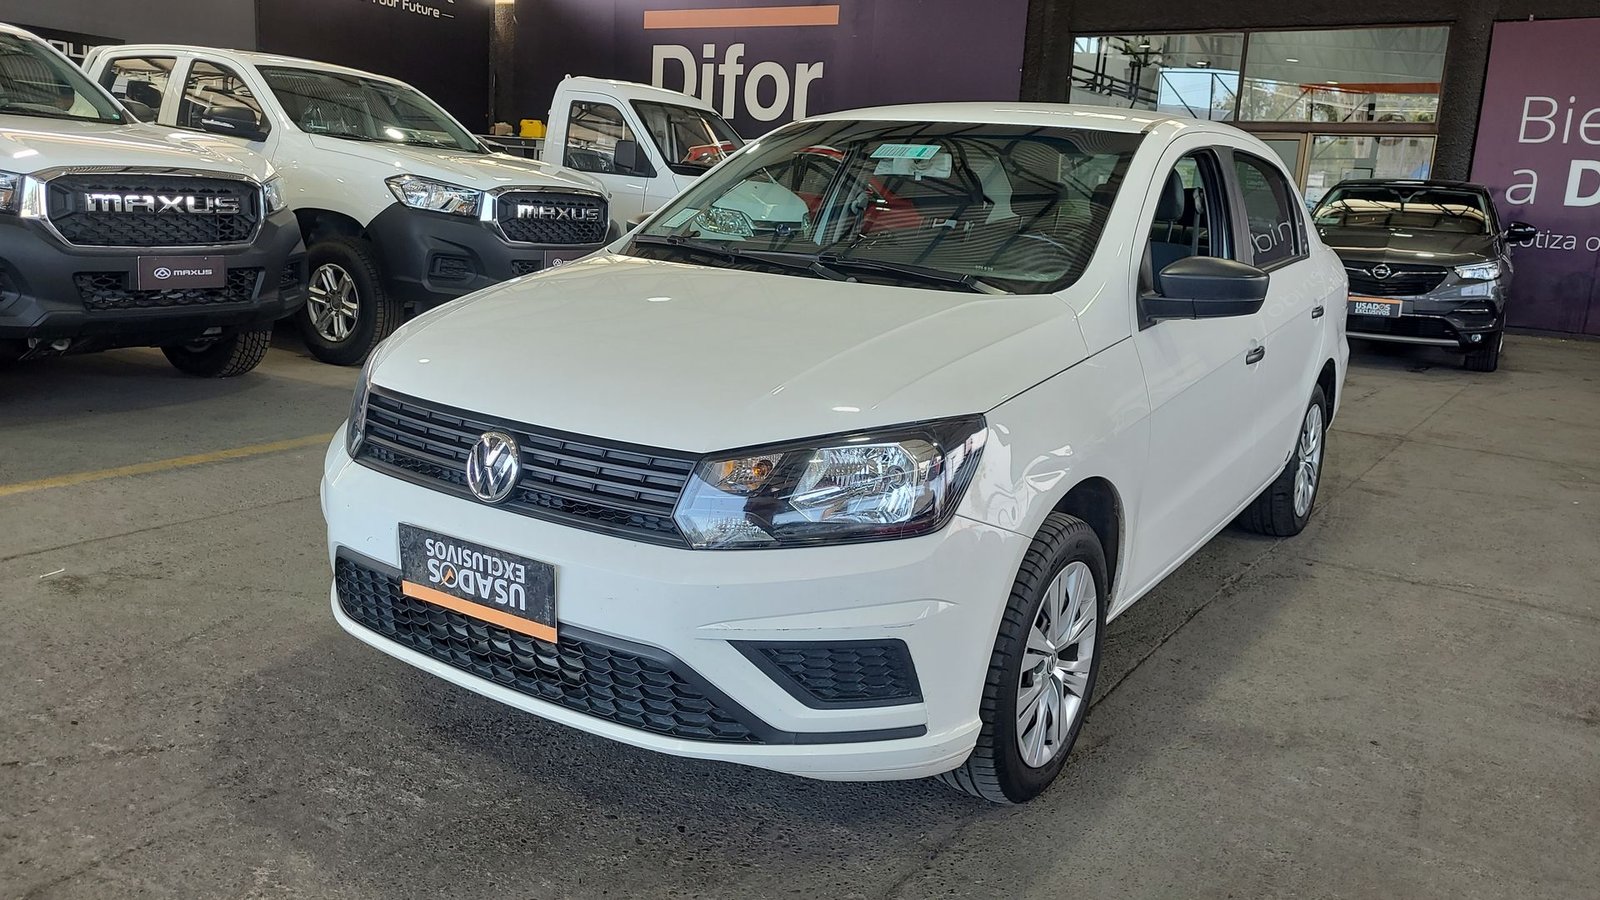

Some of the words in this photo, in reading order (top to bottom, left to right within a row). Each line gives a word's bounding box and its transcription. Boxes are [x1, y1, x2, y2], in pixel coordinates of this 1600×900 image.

[372, 0, 399, 8] our
[402, 0, 440, 18] Future
[652, 43, 824, 122] Difor
[1518, 95, 1600, 145] Bie
[85, 193, 240, 214] MAXUS
[1505, 168, 1538, 205] a
[1563, 159, 1600, 207] D
[517, 204, 600, 221] MAXUS
[1355, 302, 1391, 311] USADOS
[425, 538, 526, 584] EXCLUSIVOS
[427, 558, 526, 611] USADOS
